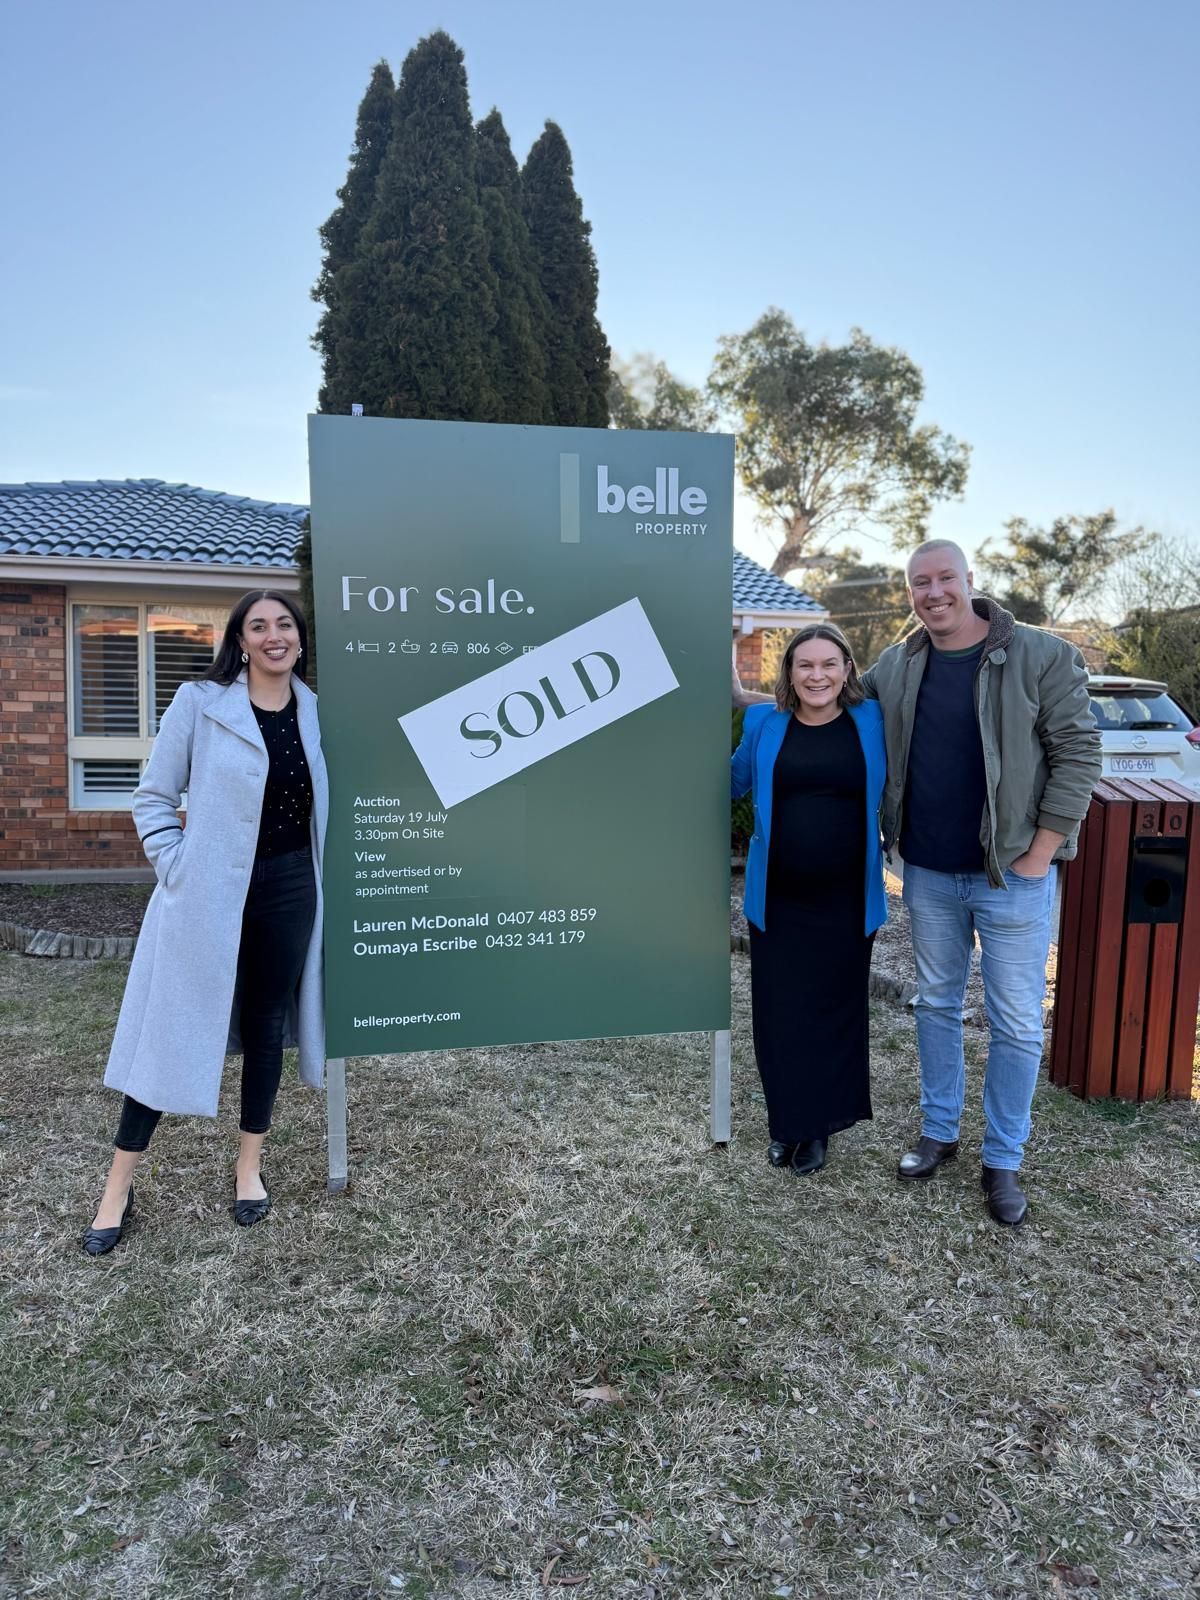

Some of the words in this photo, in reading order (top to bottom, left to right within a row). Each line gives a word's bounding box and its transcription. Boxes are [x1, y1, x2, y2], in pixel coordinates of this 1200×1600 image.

[597, 465, 707, 515] belle
[635, 523, 707, 535] PROPERTY
[342, 576, 419, 612] For
[435, 578, 535, 614] sale.
[345, 642, 354, 653] 4
[388, 642, 396, 654] 2
[429, 643, 438, 654] 2
[467, 643, 490, 654] 806
[459, 651, 621, 759] SOLD
[353, 796, 400, 807] Auction
[354, 813, 404, 824] Saturday
[409, 812, 423, 822] 19
[426, 811, 448, 823] July
[354, 829, 399, 841] 3.30pm
[402, 828, 419, 839] On
[423, 827, 444, 838] Site
[355, 851, 386, 862] View
[355, 870, 367, 879] as
[371, 867, 430, 878] advertised
[434, 867, 446, 876] or
[449, 865, 462, 877] by
[355, 884, 429, 897] appointment
[353, 918, 406, 933] Lauren
[412, 913, 489, 930] McDonald
[497, 911, 534, 925] 0407
[539, 910, 566, 923] 483
[570, 908, 597, 922] 859
[353, 939, 418, 956] Oumaya
[423, 936, 478, 952] Escribe
[486, 933, 523, 948] 0432
[527, 932, 554, 945] 341
[559, 930, 586, 944] 179
[353, 1011, 461, 1027] belleproperty.com
